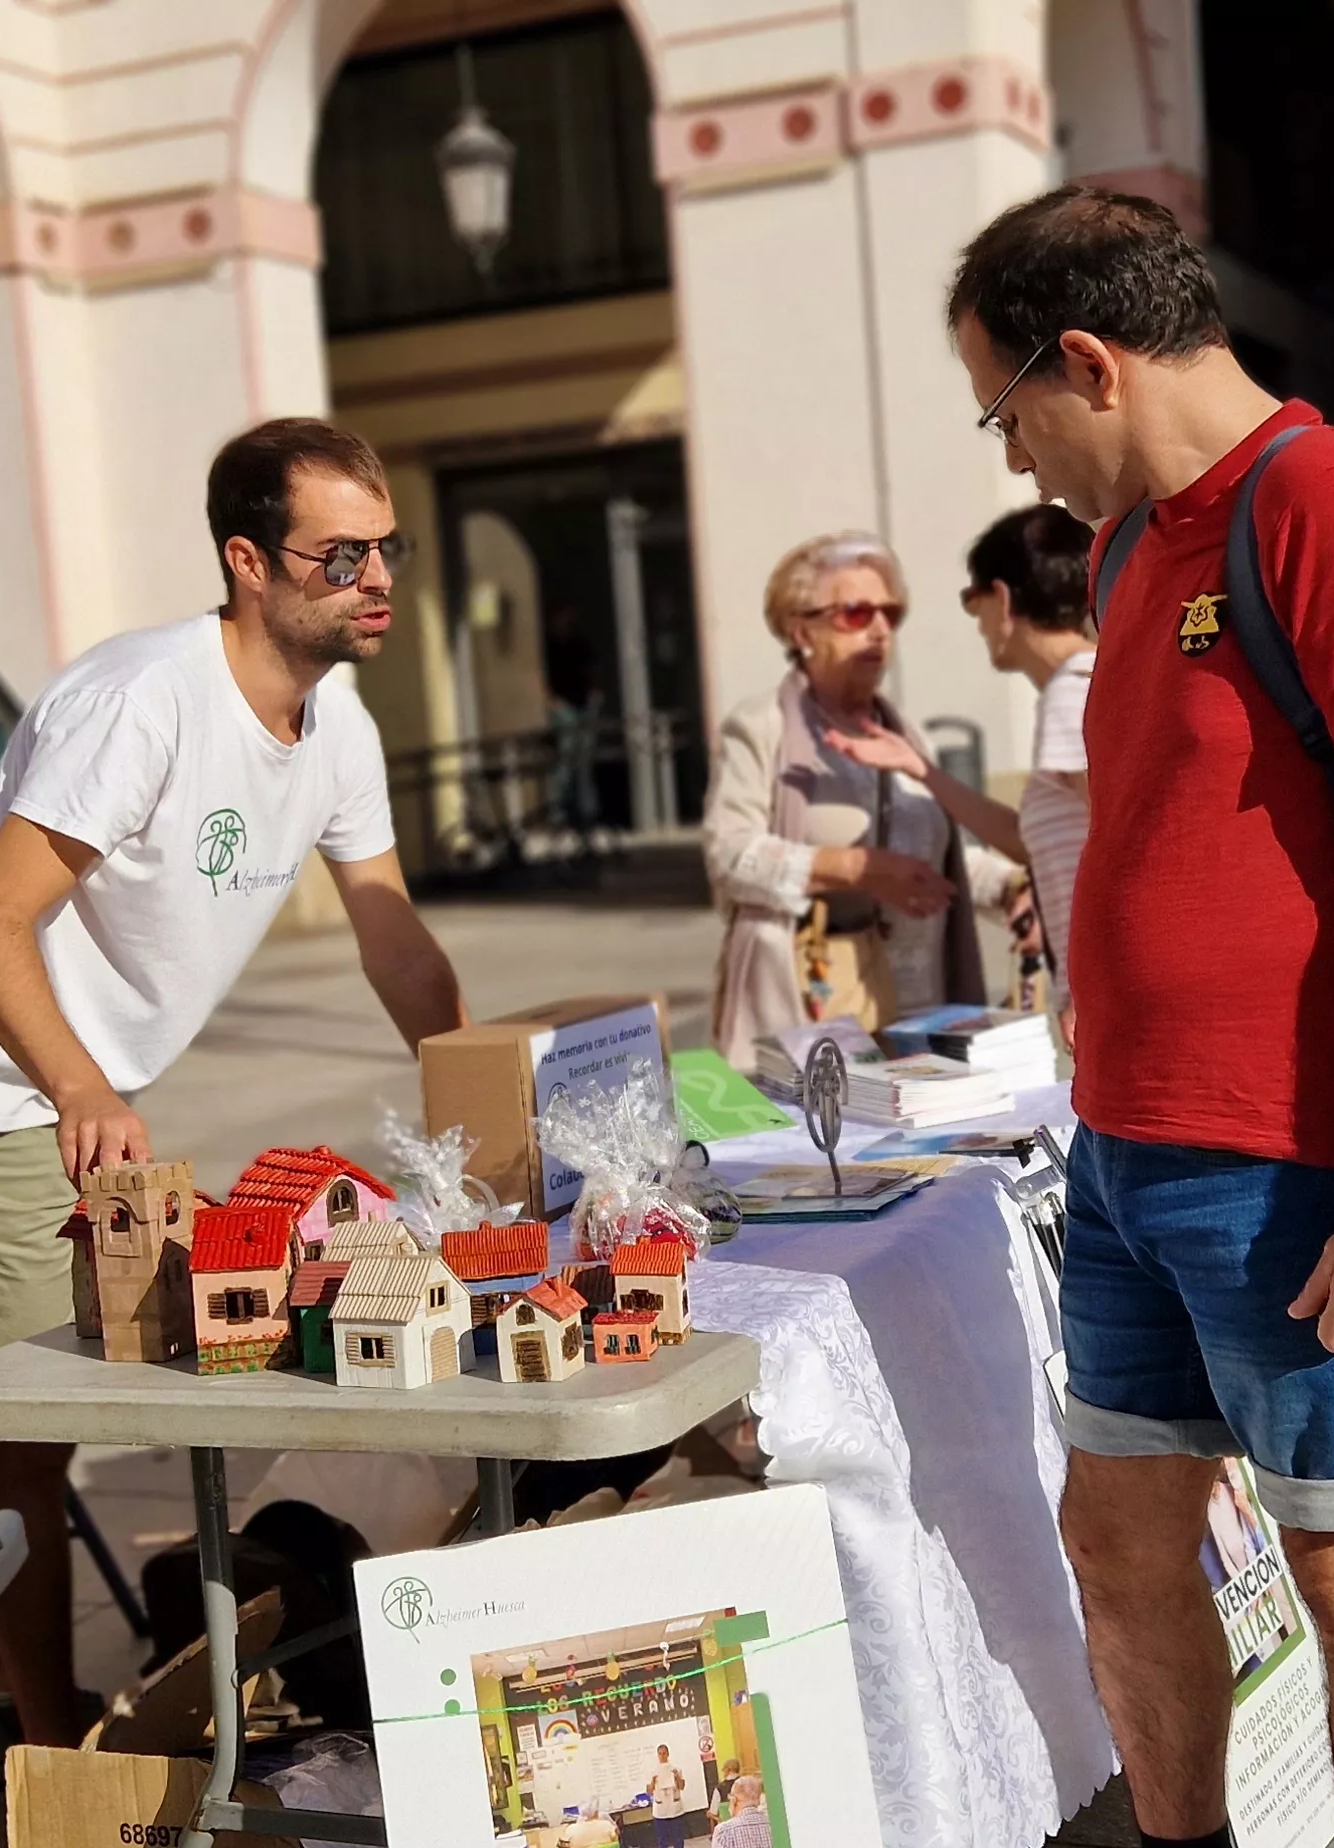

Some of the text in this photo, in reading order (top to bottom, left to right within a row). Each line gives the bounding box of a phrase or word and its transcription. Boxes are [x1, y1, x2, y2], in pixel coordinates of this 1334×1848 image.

[541, 1022, 651, 1065] Haz memoria con tu donativo
[568, 1060, 602, 1080] Recordar
[604, 1058, 613, 1069] es
[1216, 1549, 1280, 1620] VENCION
[426, 1600, 524, 1628] Alzheimer Huesca
[1228, 1596, 1282, 1667] ILIAR
[601, 1694, 690, 1723] VERANO
[1234, 1695, 1278, 1745] CUIDADOS
[1277, 1662, 1308, 1702] FÍSICOS
[1239, 1779, 1273, 1821] DESTINADO
[1277, 1746, 1304, 1779] FAMILIAS
[1246, 1799, 1278, 1837] PERSONAS
[1277, 1784, 1291, 1802] CON
[120, 1822, 184, 1848] 68697
